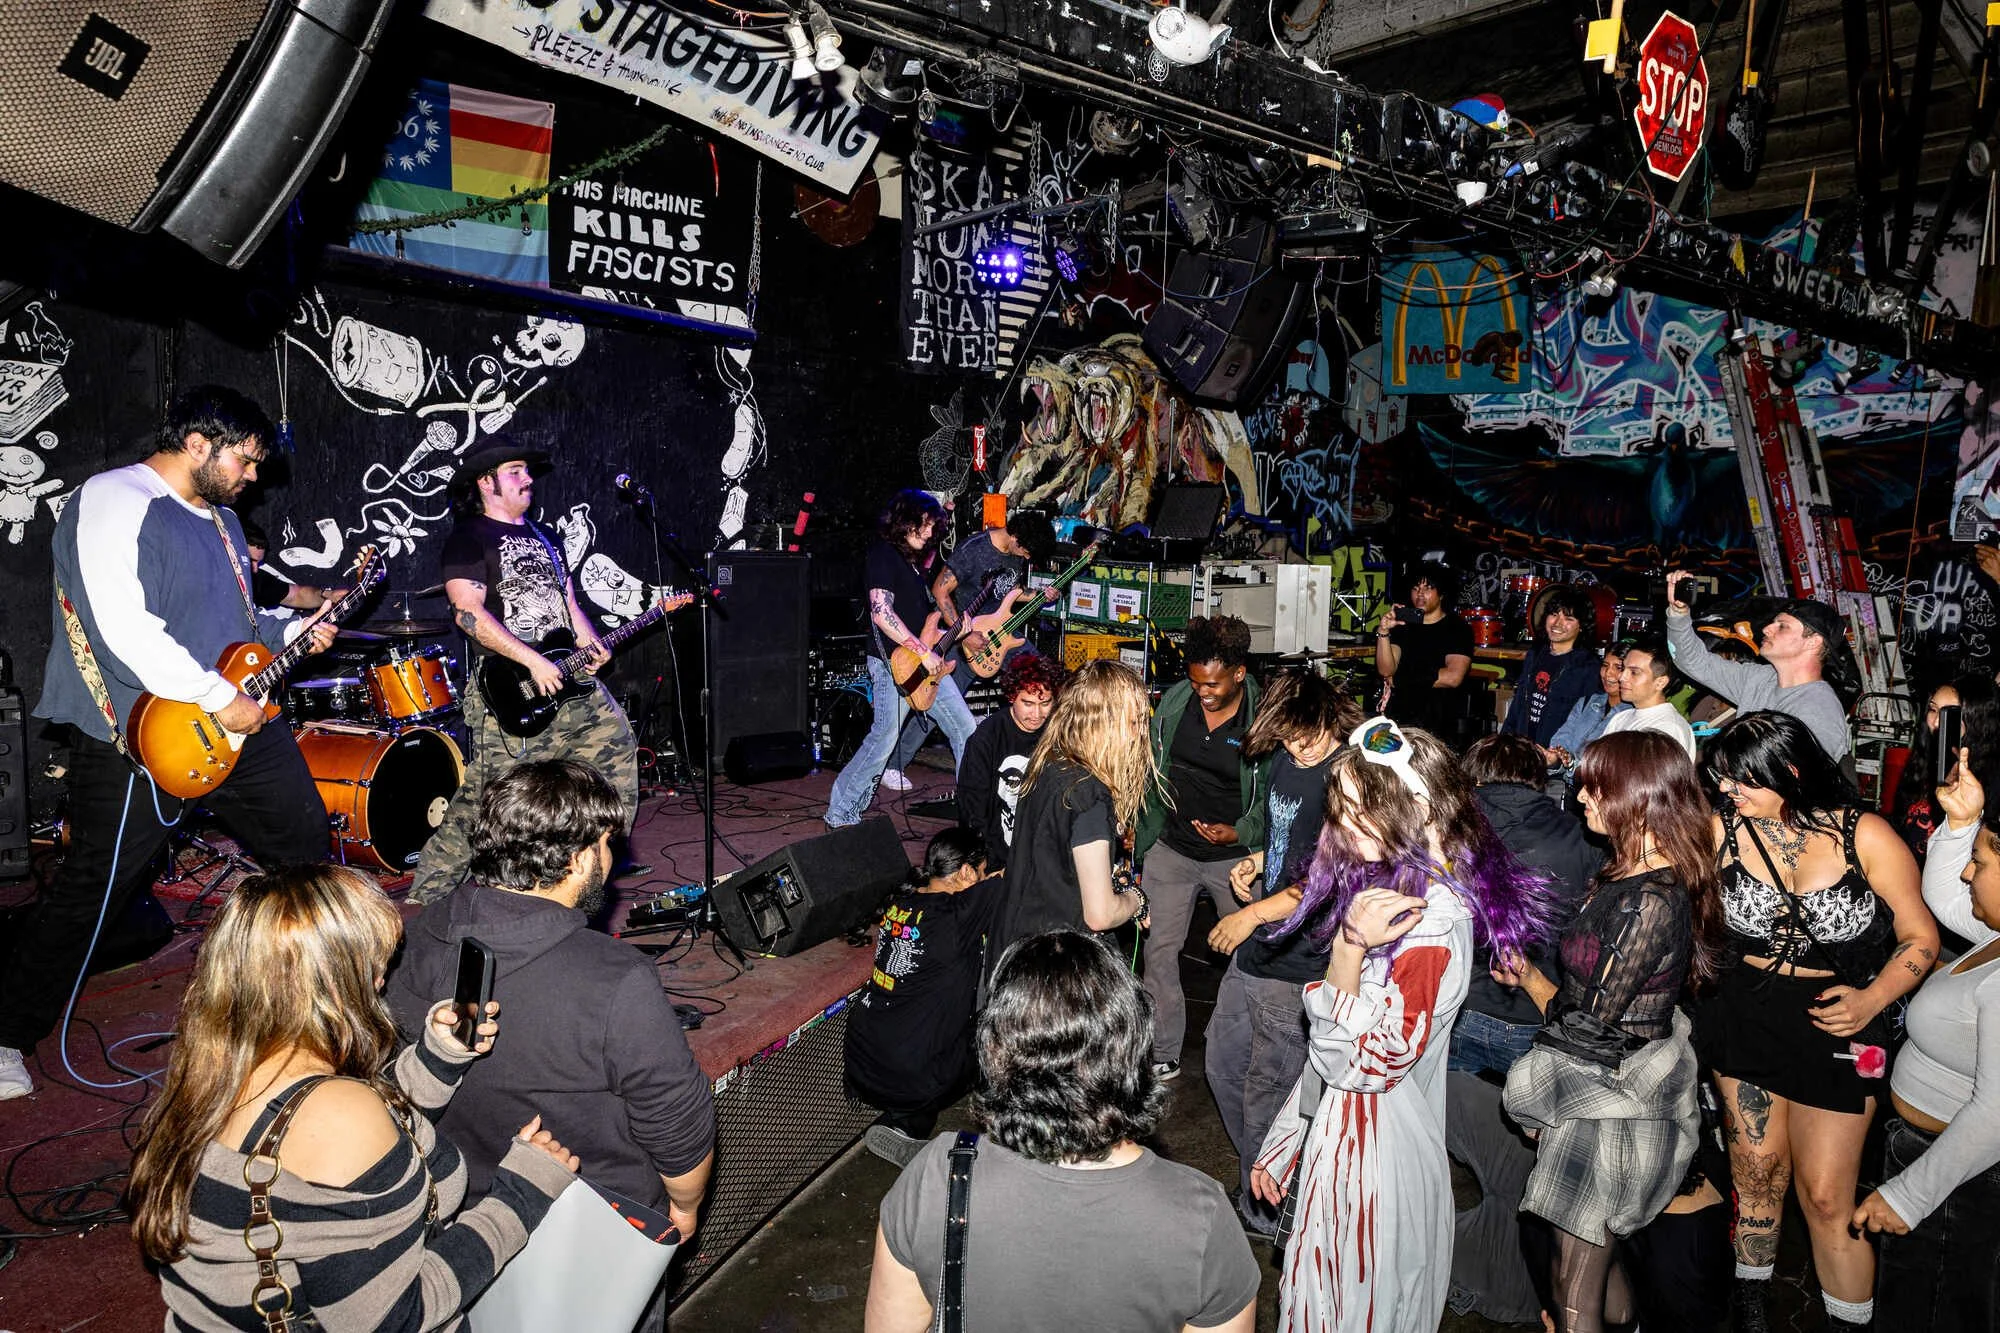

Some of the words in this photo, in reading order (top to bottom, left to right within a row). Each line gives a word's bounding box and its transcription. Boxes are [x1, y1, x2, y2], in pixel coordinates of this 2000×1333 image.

[85, 37, 126, 80] JBL
[530, 24, 602, 69] PLEEZE
[1642, 57, 1703, 132] STOP
[612, 184, 706, 218] MACHINE
[909, 152, 992, 213] SKA
[574, 205, 701, 252] KILLS
[567, 240, 736, 292] FASCISTS
[1772, 252, 1843, 306] SWEET
[912, 288, 997, 332] THAN
[907, 326, 998, 369] EVER
